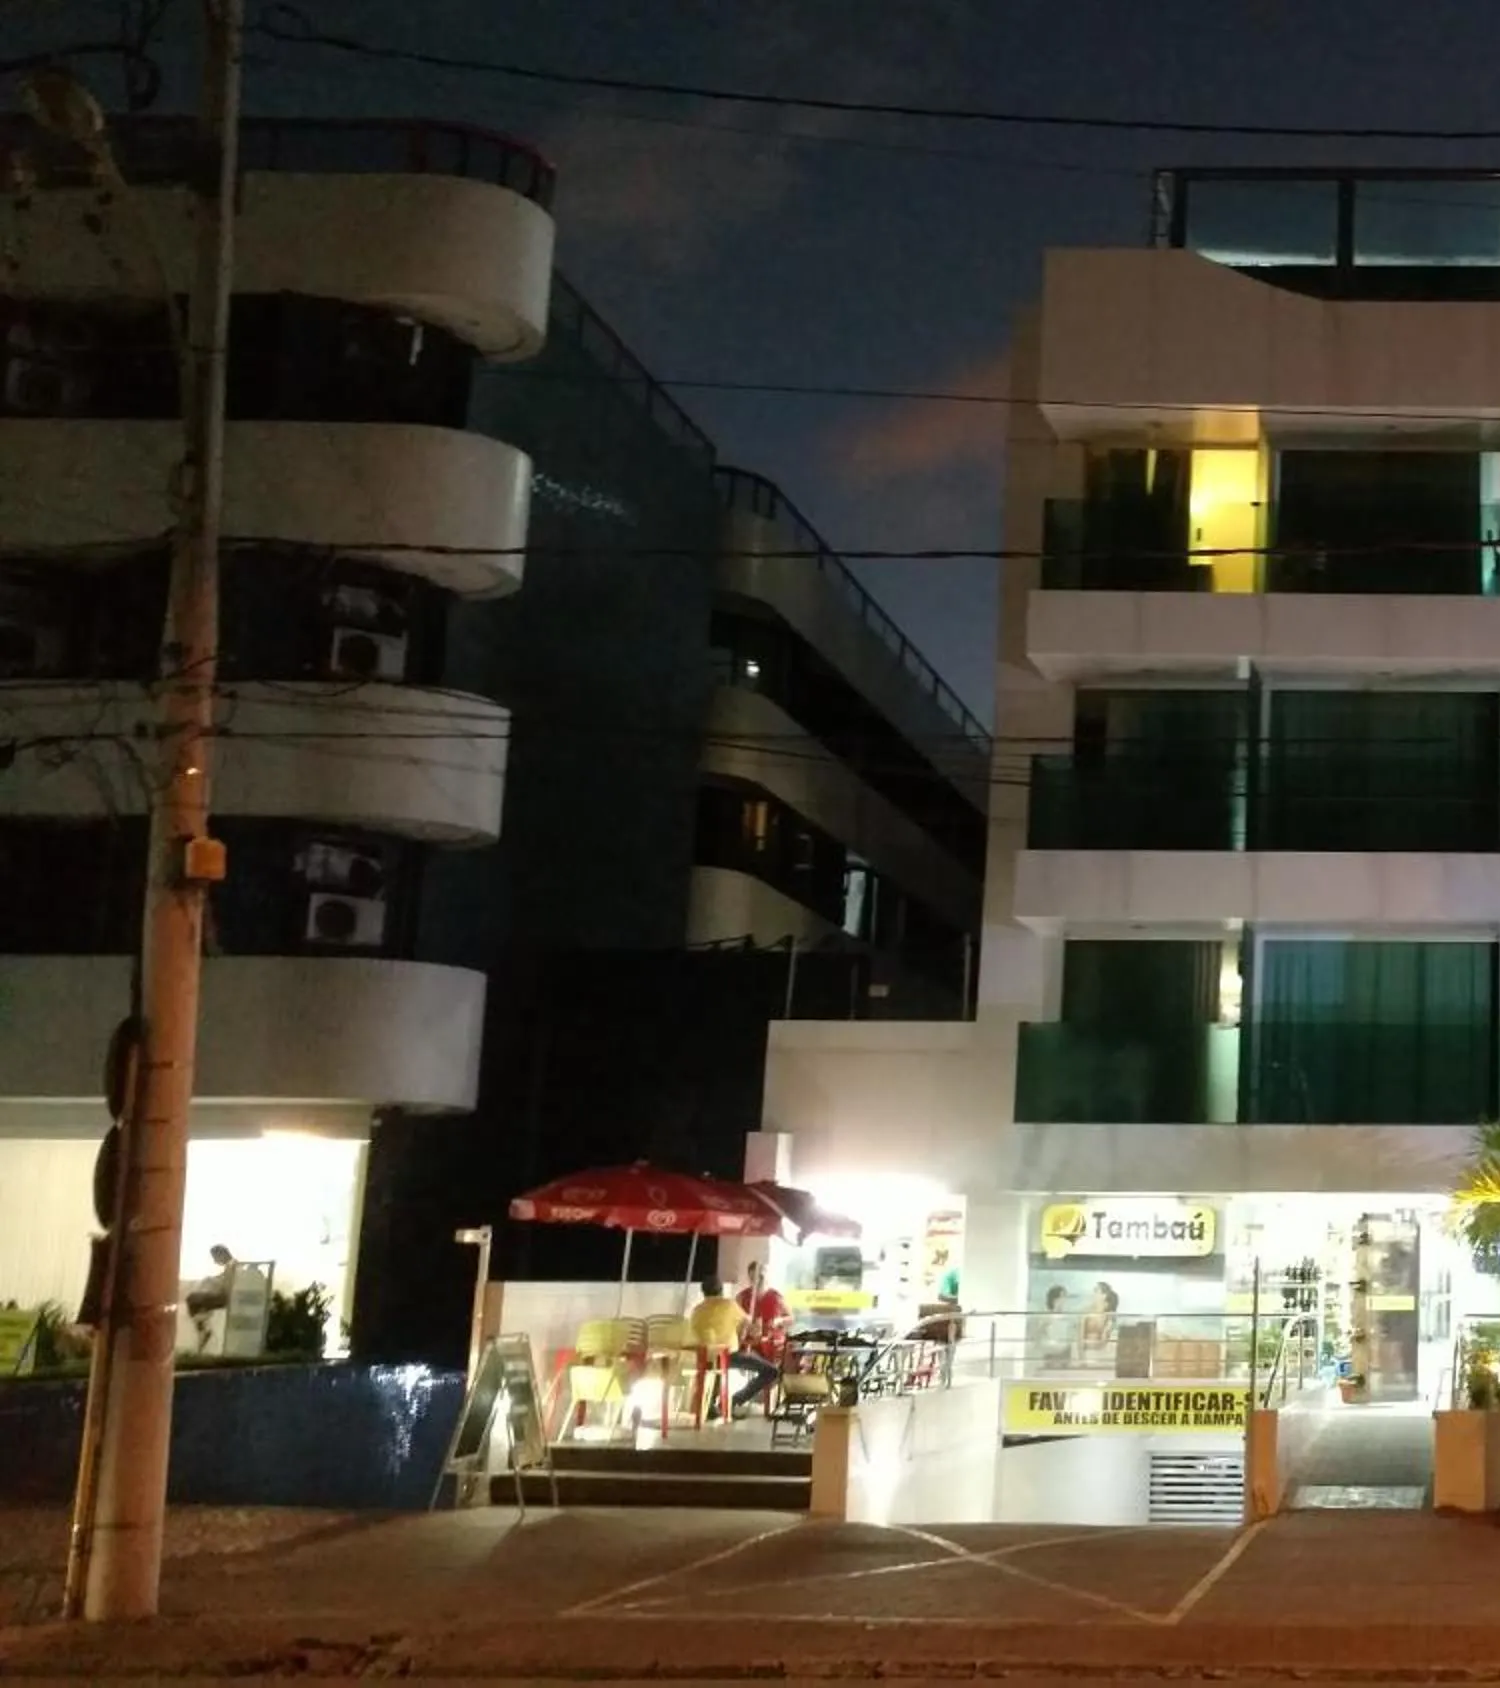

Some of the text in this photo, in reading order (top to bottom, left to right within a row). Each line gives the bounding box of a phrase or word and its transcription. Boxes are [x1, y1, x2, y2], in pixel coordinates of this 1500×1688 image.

[1092, 1212, 1205, 1241] Tambaú
[1102, 1412, 1120, 1425] DE
[1123, 1412, 1177, 1426] DESCER
[1181, 1412, 1190, 1426] A
[1193, 1412, 1245, 1426] RAMPA
